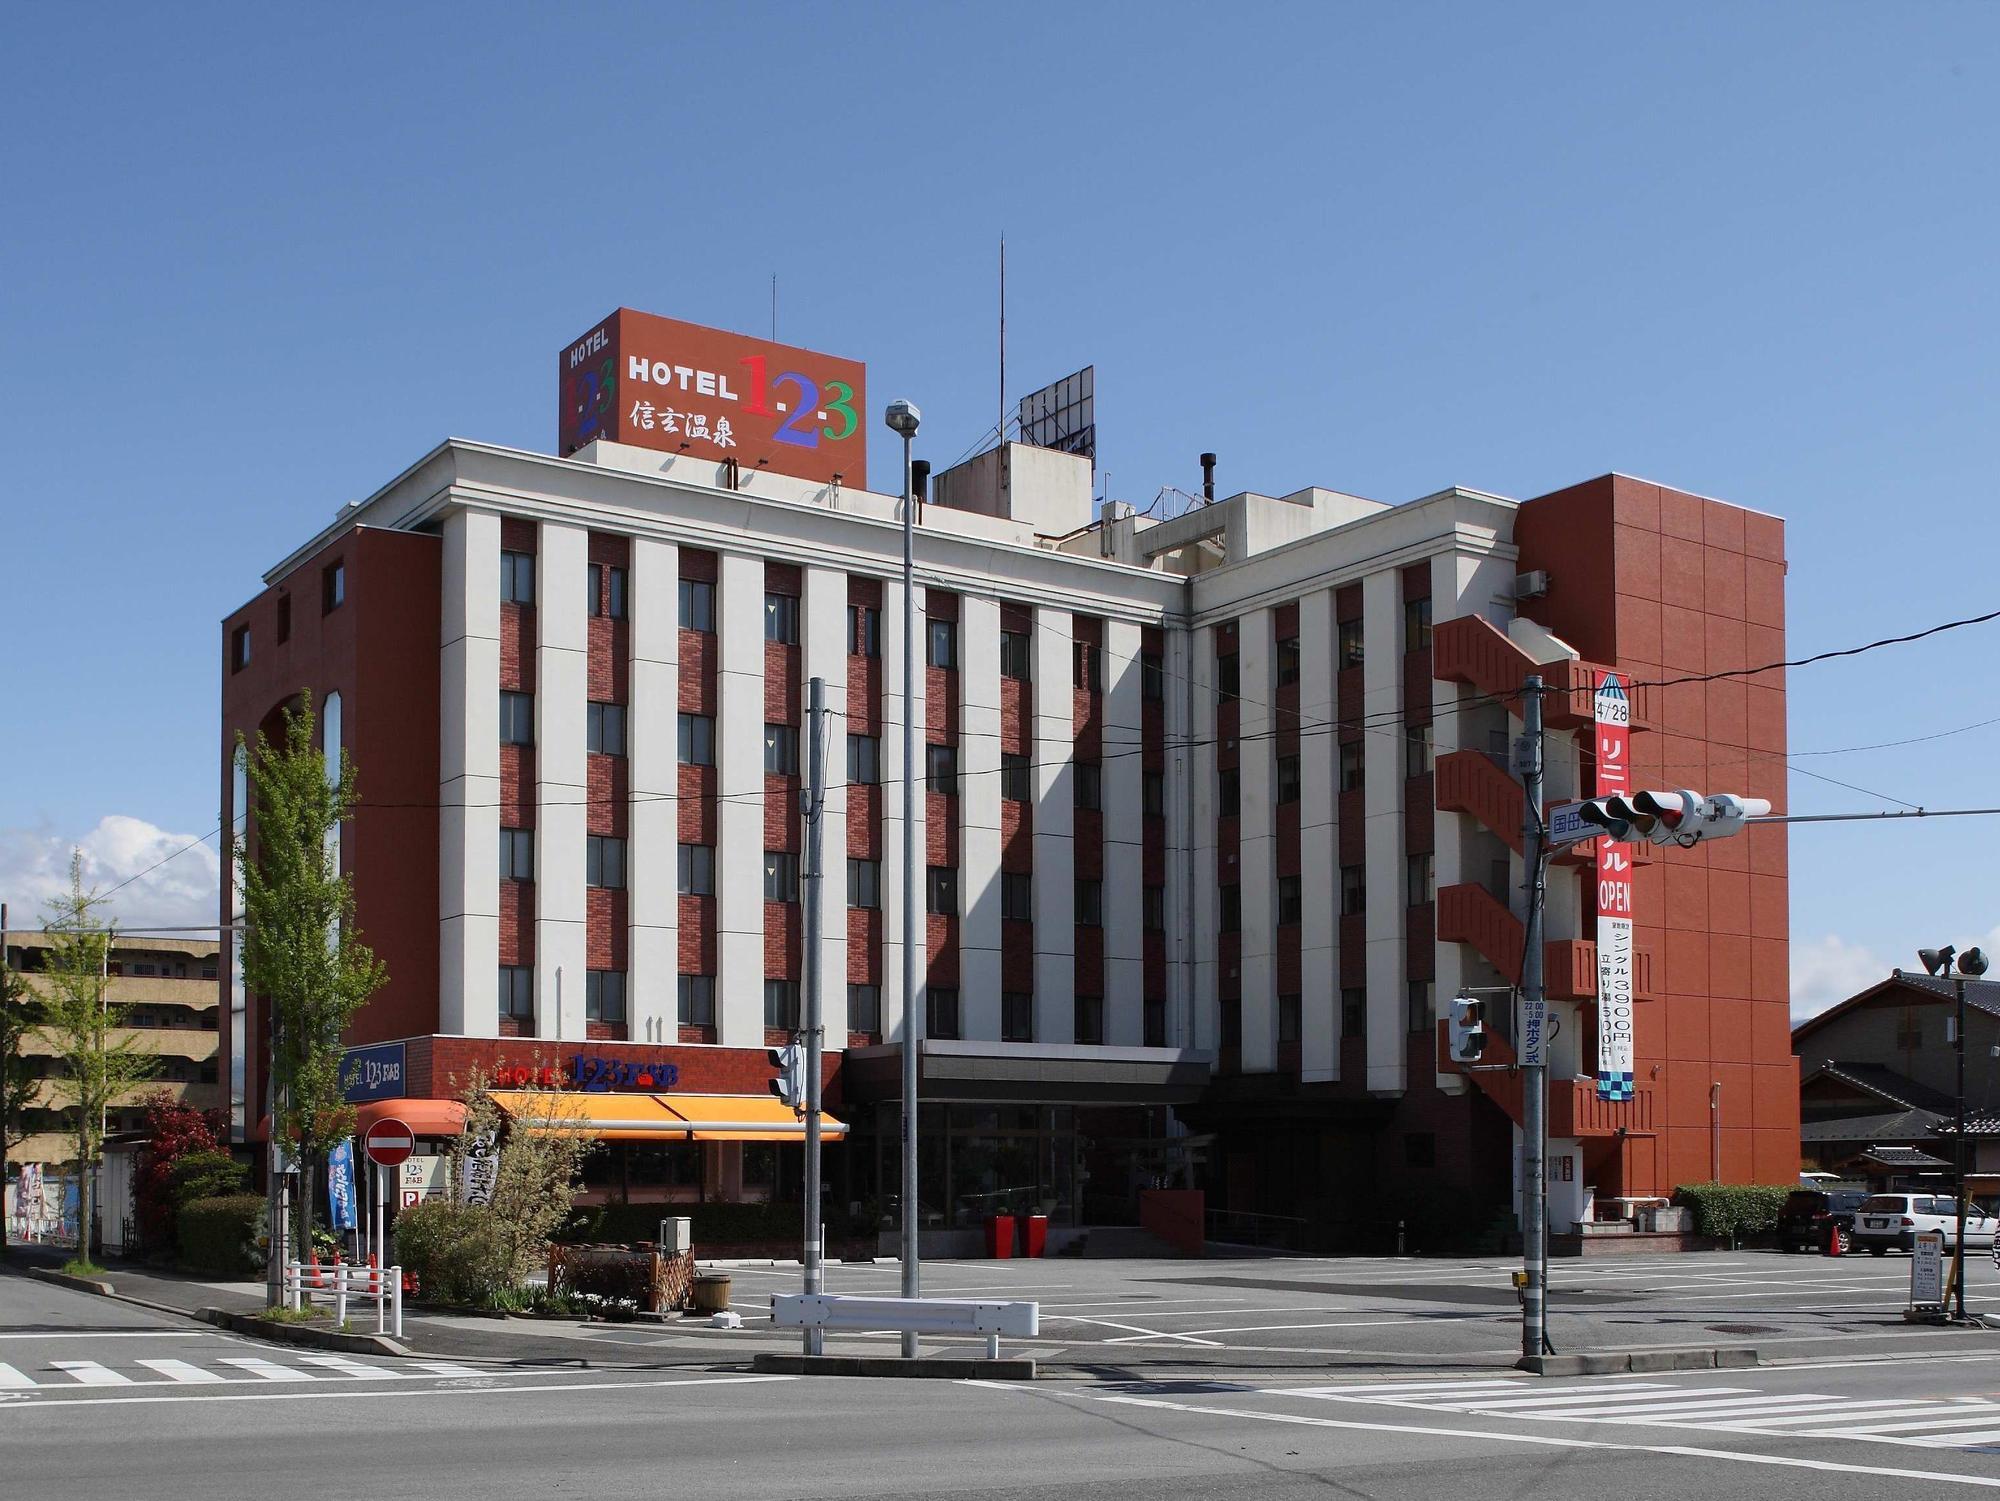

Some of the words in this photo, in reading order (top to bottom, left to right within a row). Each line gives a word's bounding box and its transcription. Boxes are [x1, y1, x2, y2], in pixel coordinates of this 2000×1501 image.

[569, 328, 609, 369] HOTEL
[628, 355, 739, 402] HOTEL
[628, 400, 738, 449] 信玄温泉
[1596, 701, 1628, 722] 4/28
[1599, 879, 1631, 912] OPEN
[1525, 1019, 1540, 1064] 押ボタン式
[364, 1059, 382, 1090] 123
[569, 1053, 622, 1092] 123
[405, 1163, 424, 1176] 123
[404, 1192, 417, 1207] P
